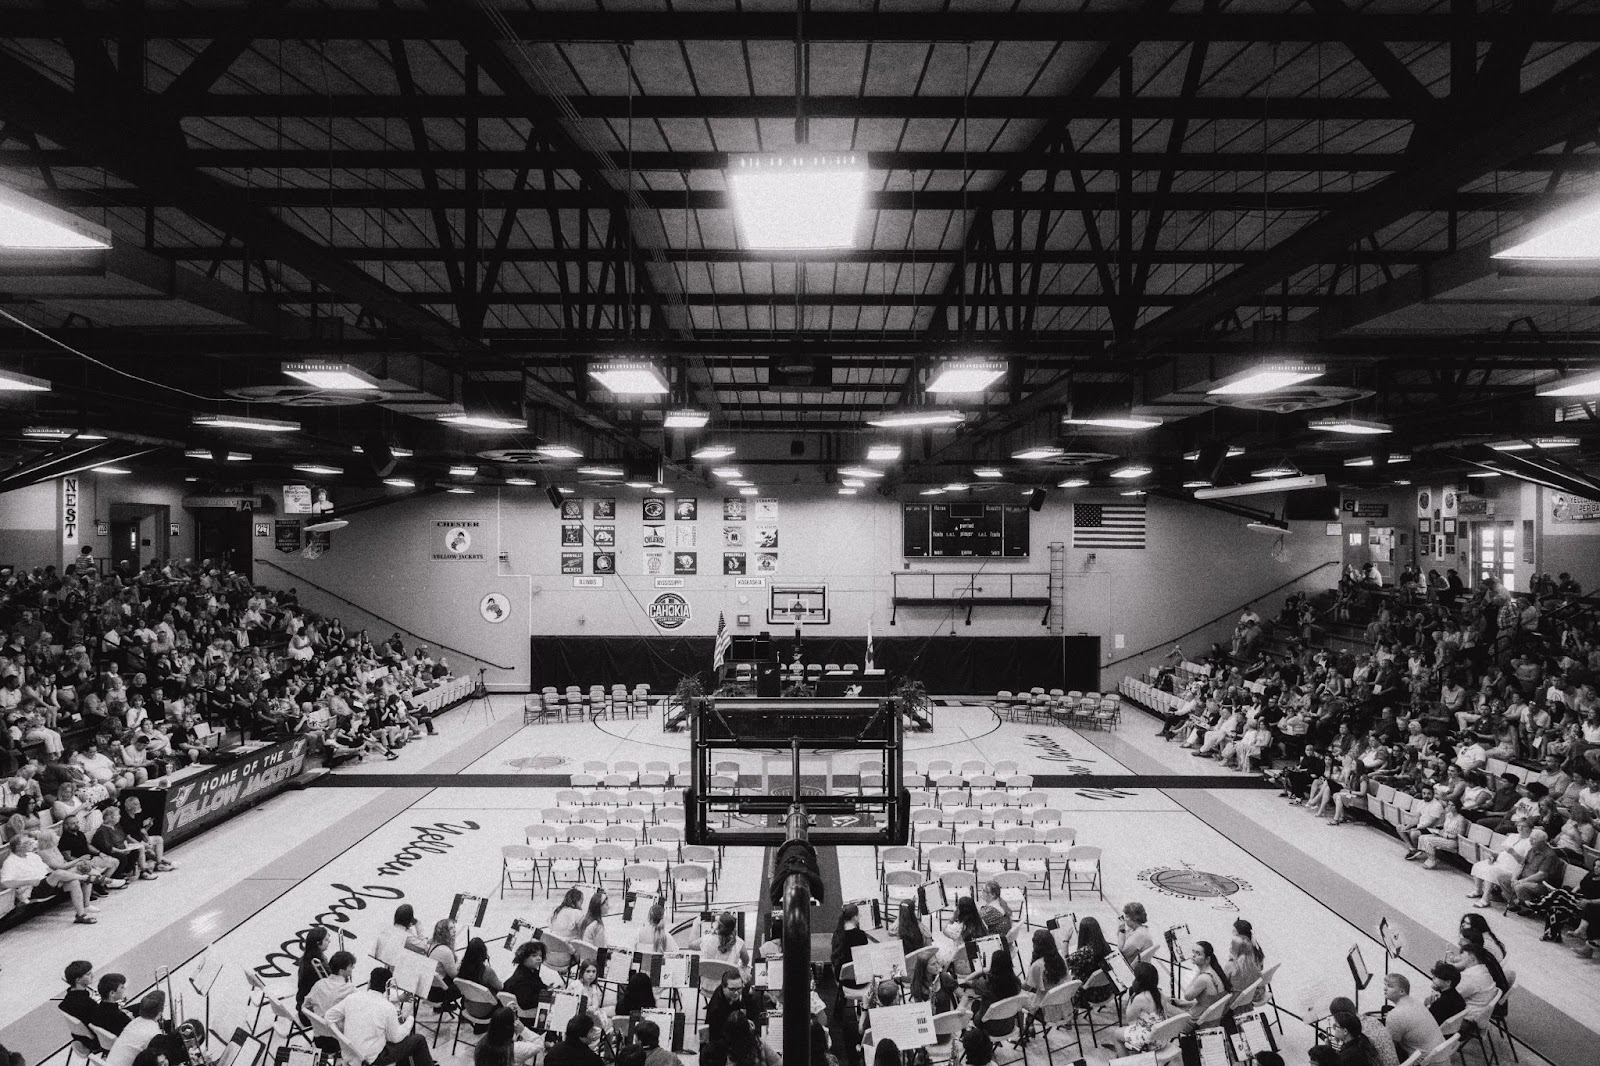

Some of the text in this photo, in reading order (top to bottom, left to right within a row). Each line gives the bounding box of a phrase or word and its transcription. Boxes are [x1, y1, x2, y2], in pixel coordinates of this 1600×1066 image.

[65, 479, 76, 538] NEST
[242, 502, 251, 511] A
[1344, 501, 1354, 511] G
[649, 604, 690, 618] CAHOKIA
[166, 754, 305, 833] YELLOW JACKETS
[200, 750, 284, 795] HOME OF THE
[376, 820, 481, 876] Yellow
